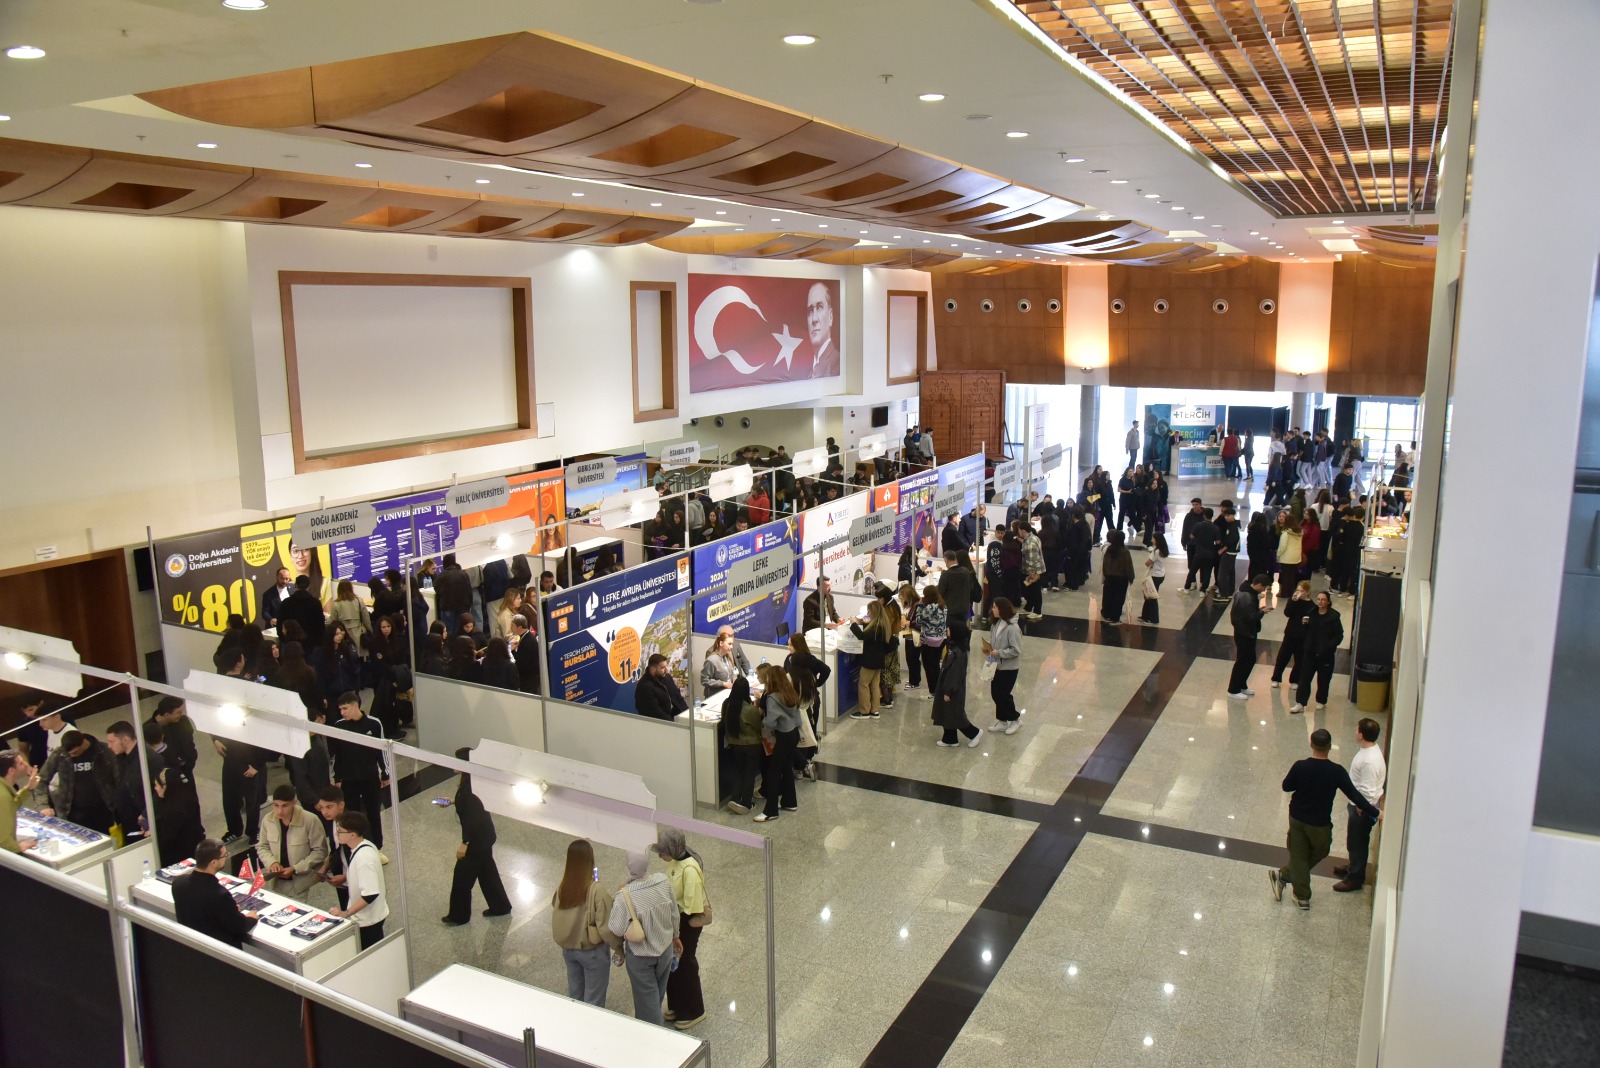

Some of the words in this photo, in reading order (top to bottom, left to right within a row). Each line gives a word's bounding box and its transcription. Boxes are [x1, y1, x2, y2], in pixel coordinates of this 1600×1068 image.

[577, 463, 592, 473] KIBRIS
[577, 470, 604, 484] ÜNİVERSİTESİ
[455, 493, 471, 505] HALİÇ
[471, 486, 505, 502] ÜNİVERSİTESİ
[310, 514, 329, 527] DOĞU
[330, 509, 359, 525] AKDENİZ
[864, 513, 883, 528] İSTANBUL
[311, 524, 356, 541] ÜNİVERSİTESİ
[852, 531, 868, 547] GELİŞİM
[868, 521, 893, 541] ÜNİVERSİTESİ
[188, 550, 209, 562] Doğu
[210, 546, 239, 558] Akdeniz
[813, 547, 846, 570] ünversitede
[189, 556, 232, 571] Üniversitesi
[752, 556, 769, 572] LEFKE
[602, 590, 620, 605] LEFKE
[621, 583, 642, 598] AVRUPA
[642, 569, 677, 591] ÜNİVERSİTESİ
[732, 578, 755, 599] AVRUPA
[755, 563, 789, 589] ÜNİVERSİTESİ
[563, 649, 581, 660] TERCİH
[563, 648, 597, 668] BURSLARI
